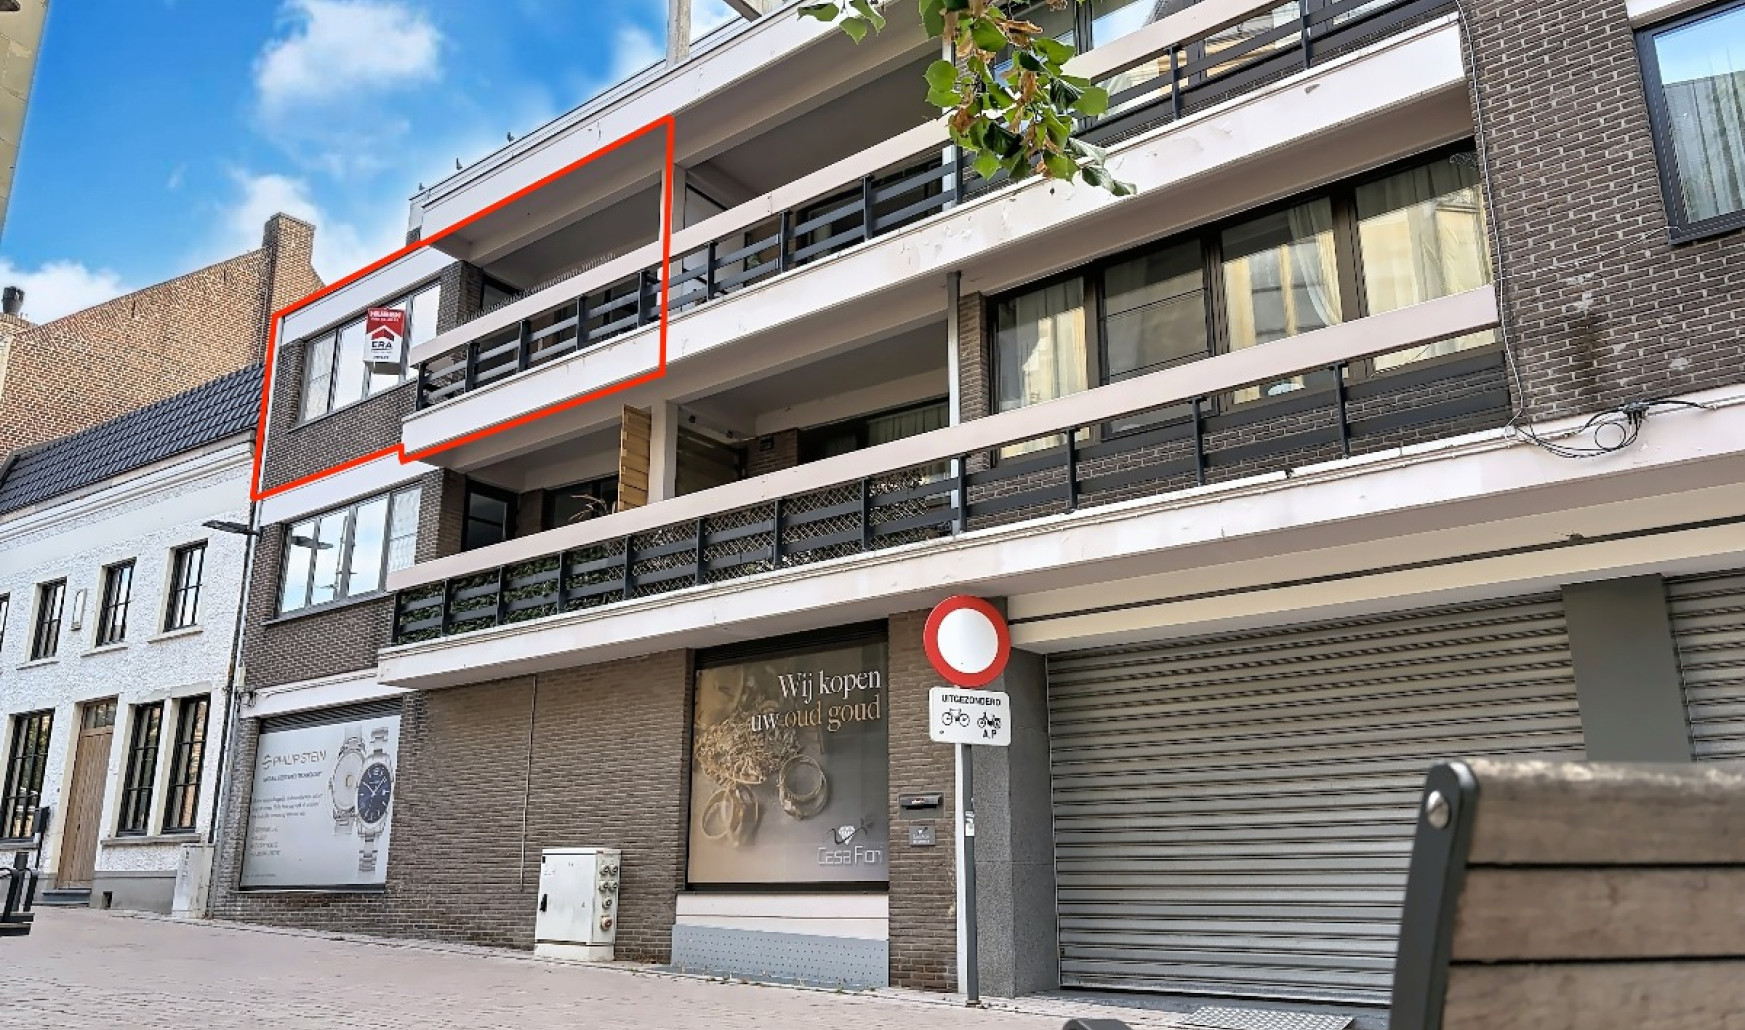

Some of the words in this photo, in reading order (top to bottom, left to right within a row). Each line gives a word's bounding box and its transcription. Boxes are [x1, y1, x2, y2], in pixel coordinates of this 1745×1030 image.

[777, 672, 813, 704] Wij
[818, 669, 882, 700] kopen
[751, 713, 780, 732] uw
[784, 700, 822, 727] oud
[827, 693, 881, 732] goud
[941, 694, 1002, 706] UITGEZONDERD
[816, 847, 852, 865] Casa
